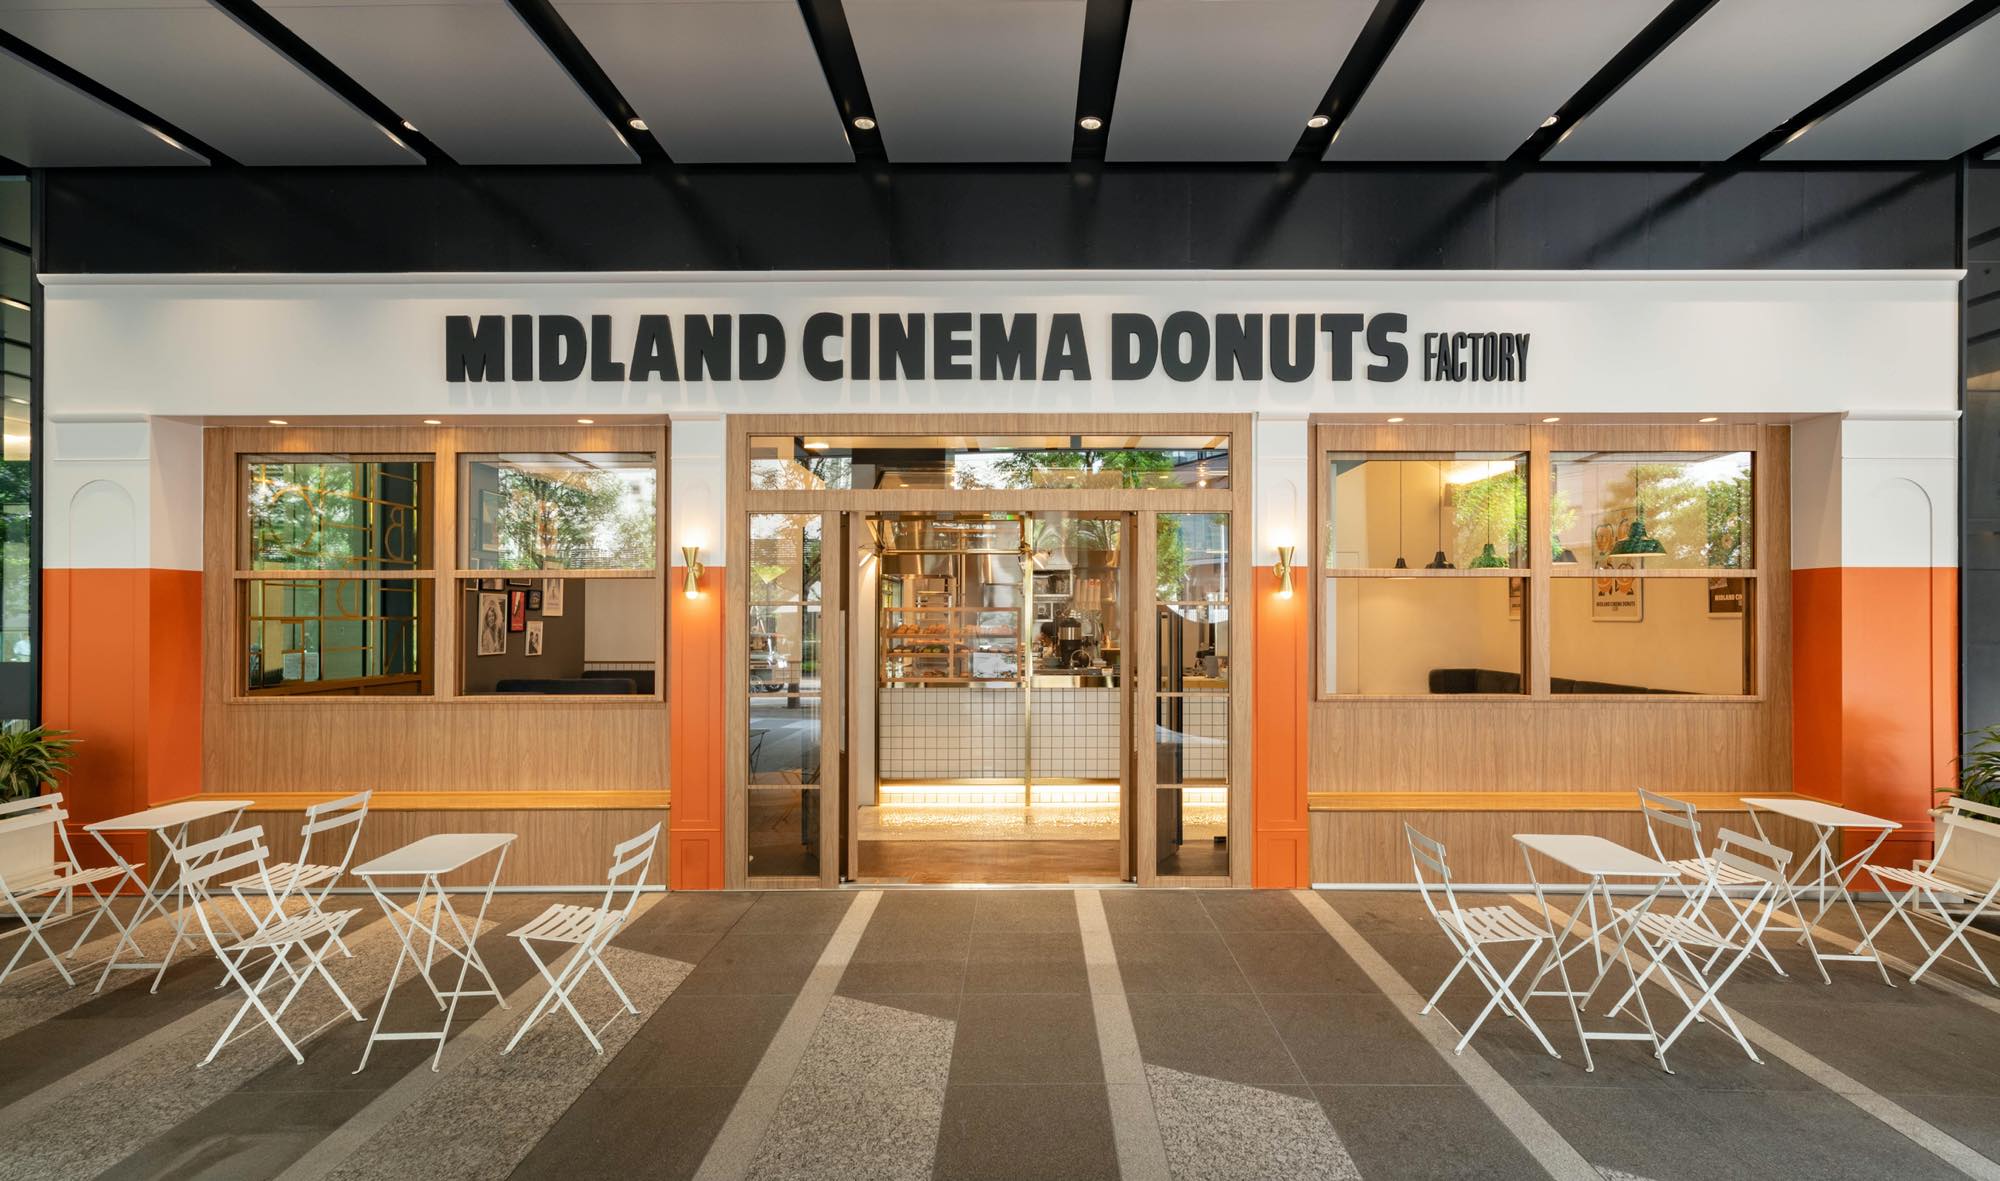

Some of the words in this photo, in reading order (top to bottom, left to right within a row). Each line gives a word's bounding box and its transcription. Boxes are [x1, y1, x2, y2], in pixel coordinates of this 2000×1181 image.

[446, 314, 787, 383] MIDLAND
[803, 312, 1092, 382] CINEMA
[1112, 311, 1409, 383] DONUTS
[1424, 332, 1531, 382] FACTORY
